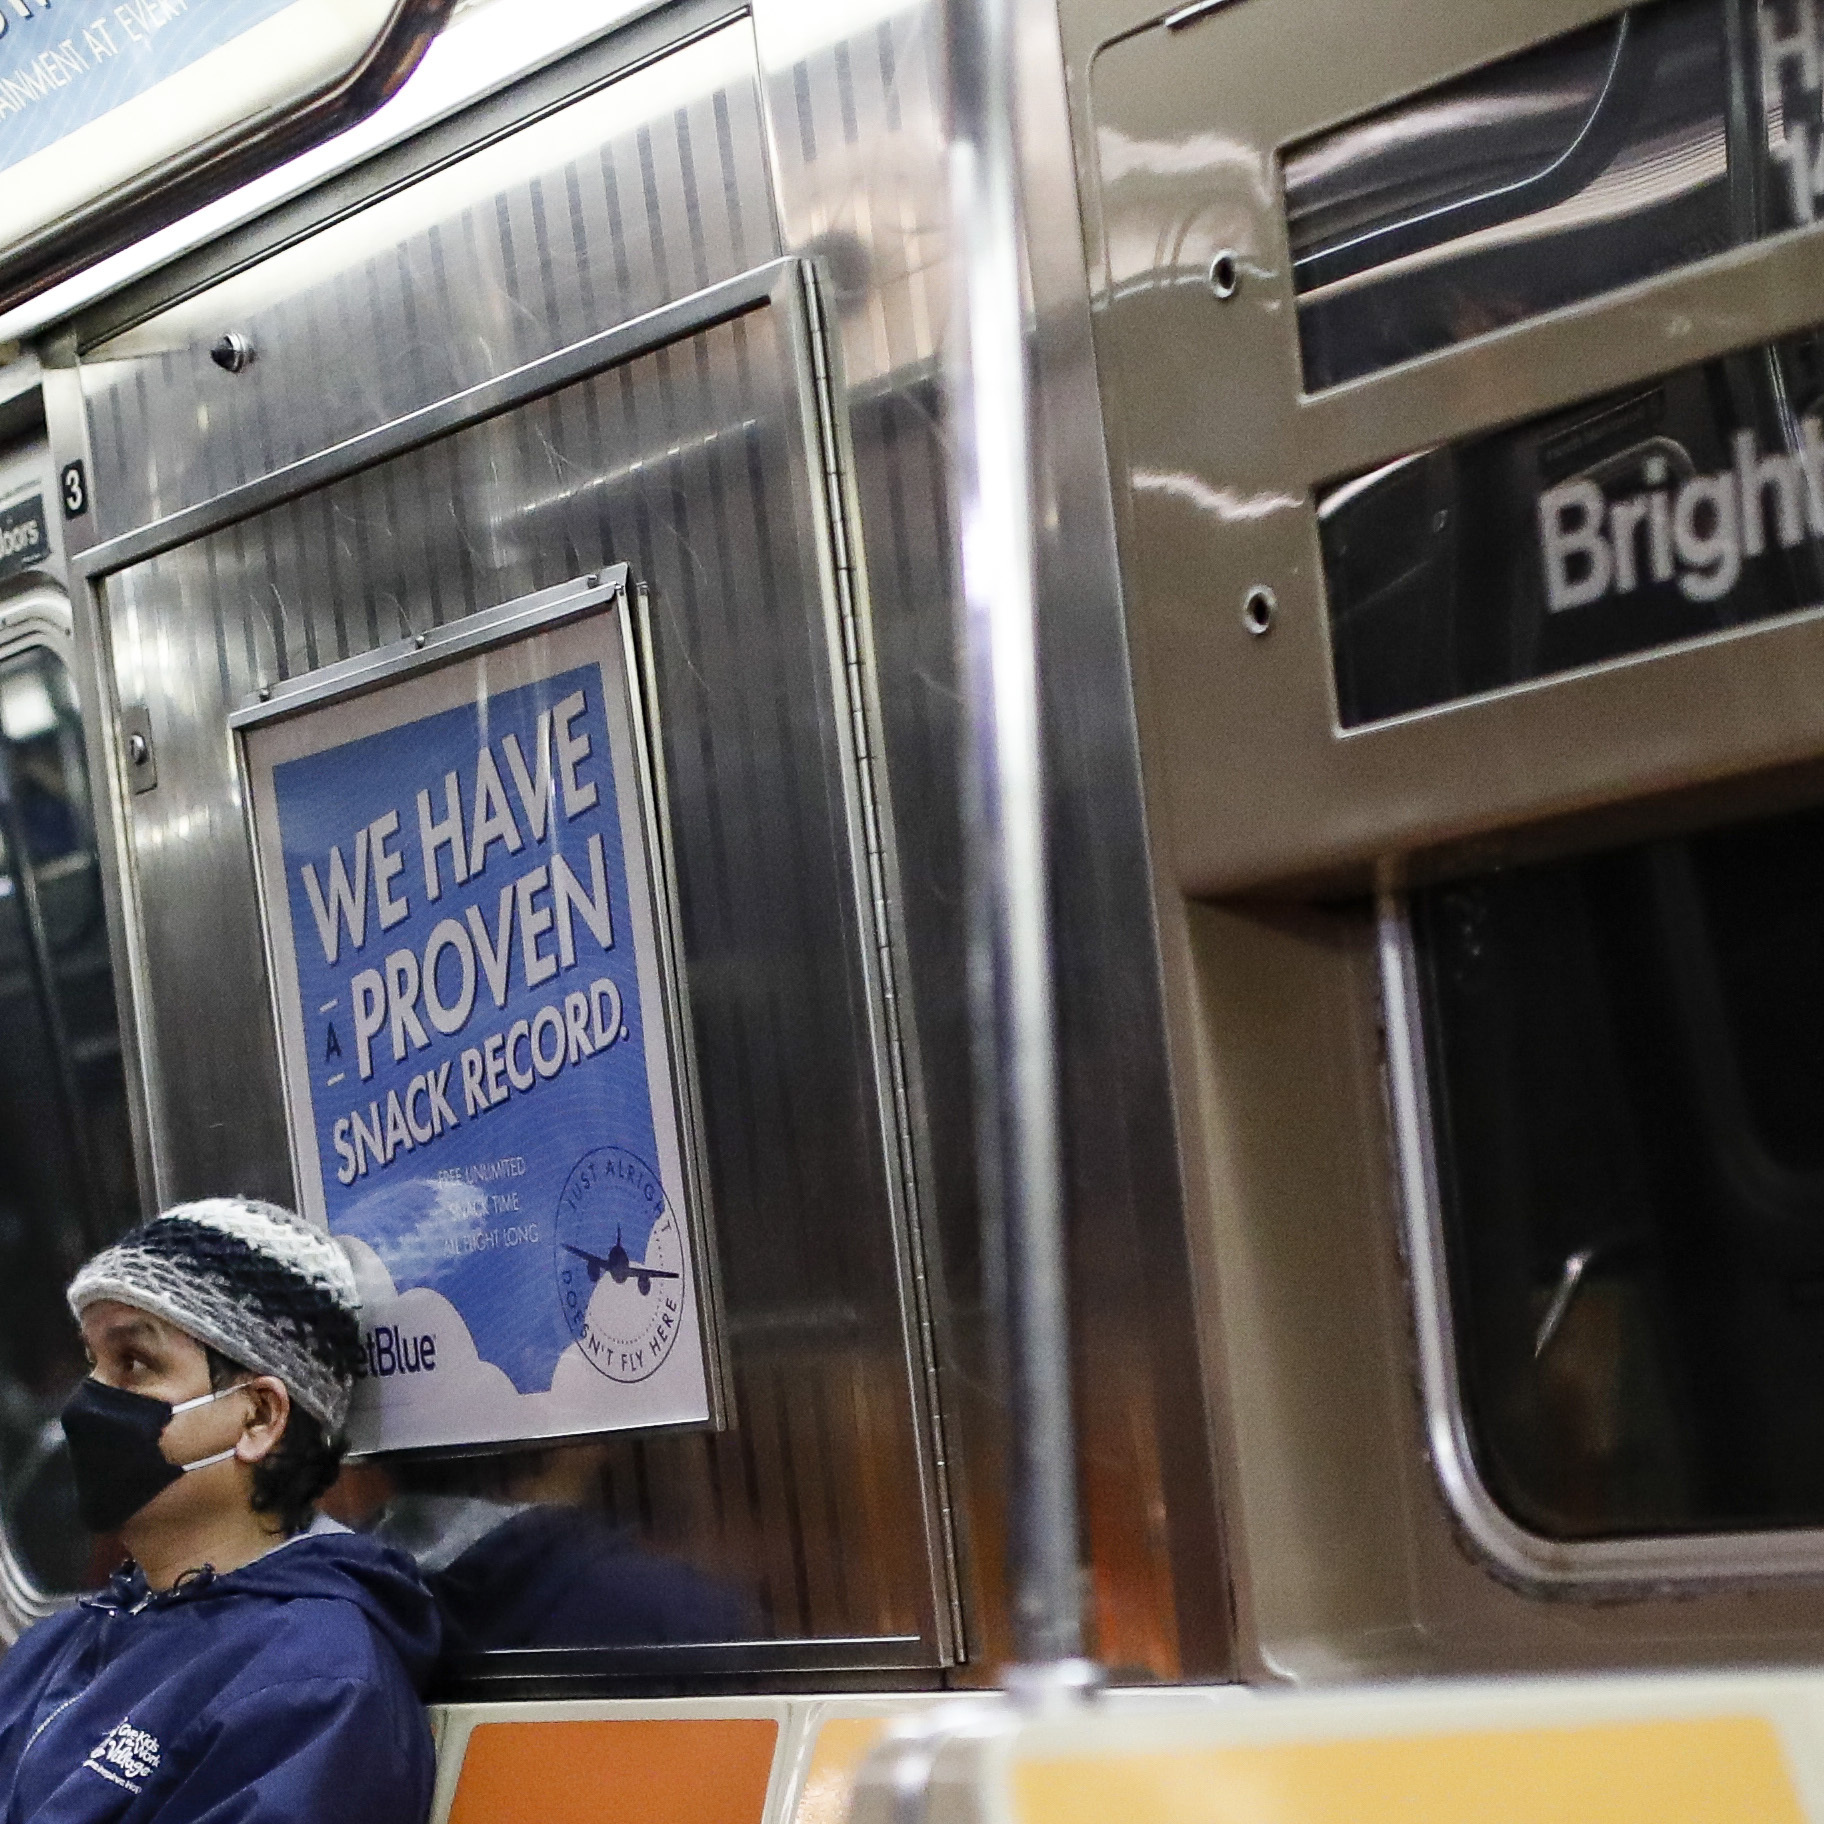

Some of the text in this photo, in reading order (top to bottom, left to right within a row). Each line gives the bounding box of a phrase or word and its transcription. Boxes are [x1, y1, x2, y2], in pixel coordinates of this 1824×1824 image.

[83, 16, 119, 63] AT
[65, 469, 84, 511] 3
[300, 689, 601, 967] WE HAVE
[351, 832, 616, 1084] PROVEN
[325, 1021, 342, 1063] A
[333, 976, 630, 1188] SNACK RECORD.
[464, 1156, 526, 1186] UNLIMITED
[491, 1192, 520, 1214] TIME
[566, 1158, 672, 1234] JUST ALRIGHT
[503, 1222, 539, 1248] LONG
[561, 1269, 677, 1373] DOESN'T FLY HERE
[135, 1730, 160, 1753] Kids
